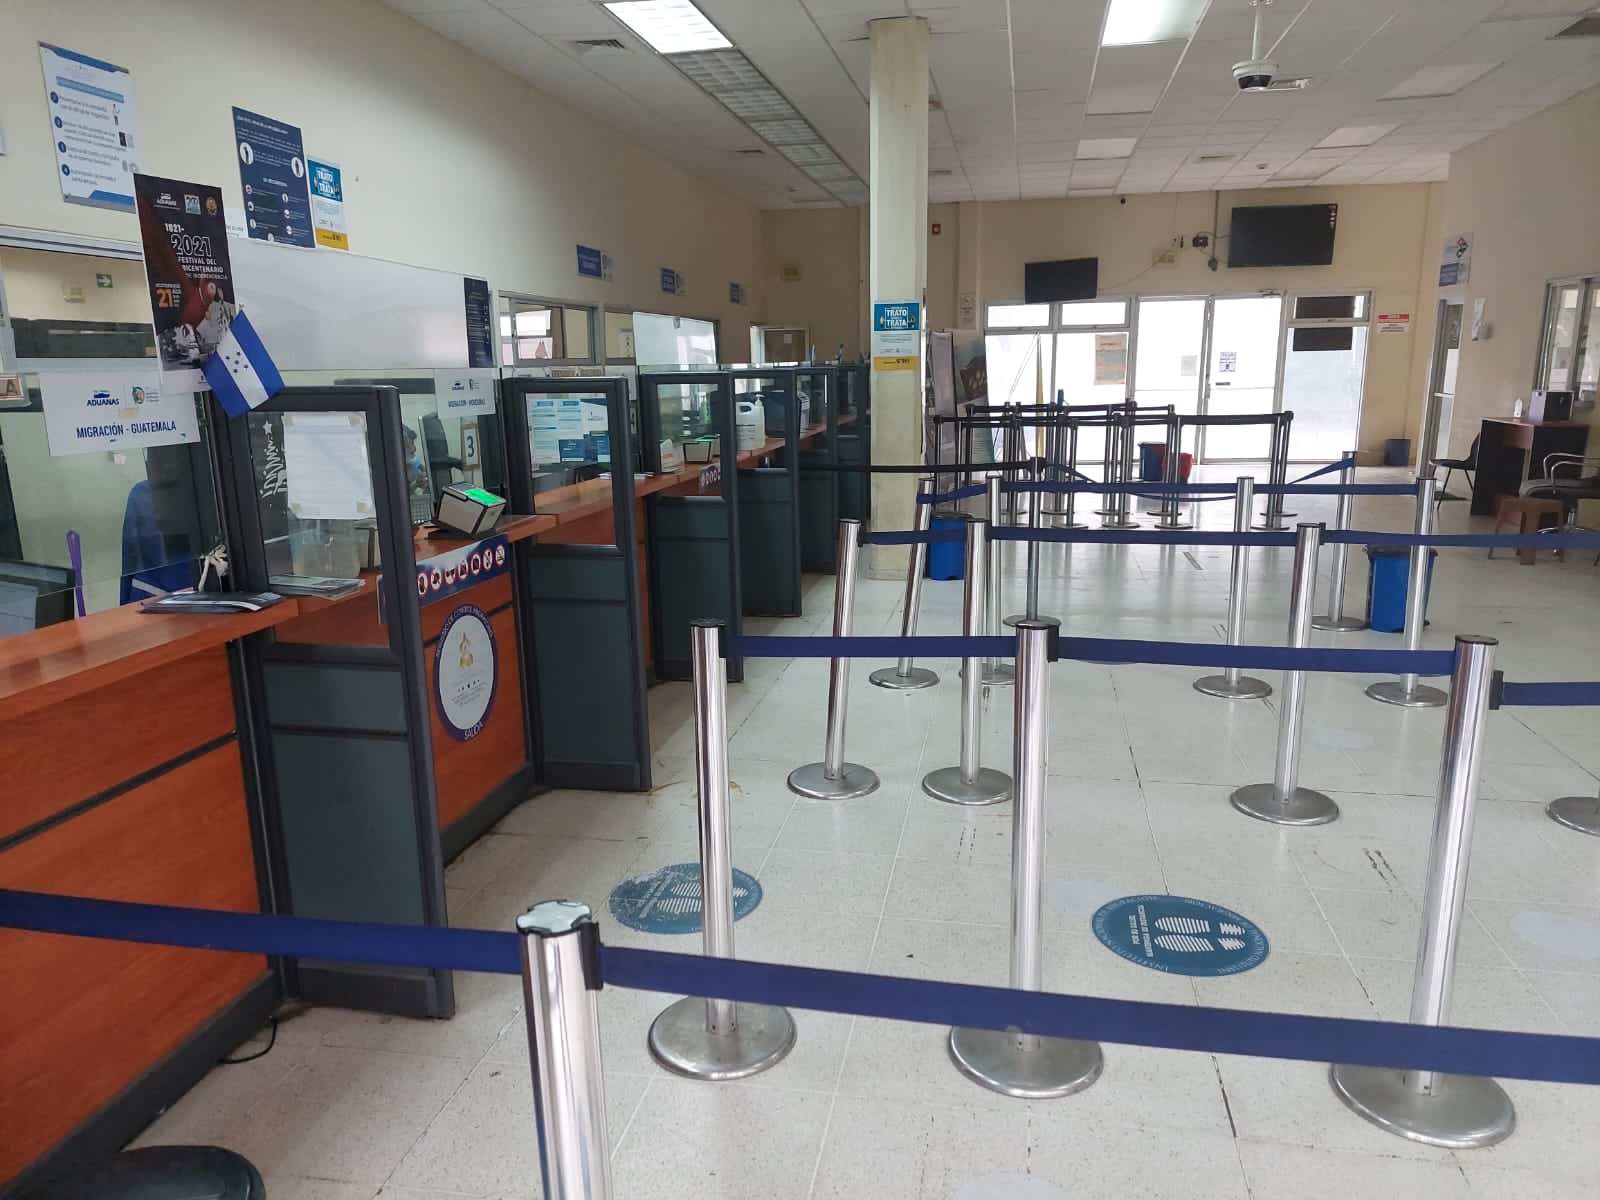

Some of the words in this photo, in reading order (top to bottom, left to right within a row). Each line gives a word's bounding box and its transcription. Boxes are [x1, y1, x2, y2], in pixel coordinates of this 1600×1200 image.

[170, 233, 212, 257] 2021
[178, 256, 205, 265] FESTIVAL
[181, 265, 224, 273] BICENTENARIO
[156, 288, 173, 308] 21
[886, 319, 907, 327] TRATA
[86, 398, 119, 407] ADUANAS
[76, 421, 124, 439] MIGRACIÓN
[130, 420, 176, 435] GUATEMALA
[466, 435, 475, 458] 3
